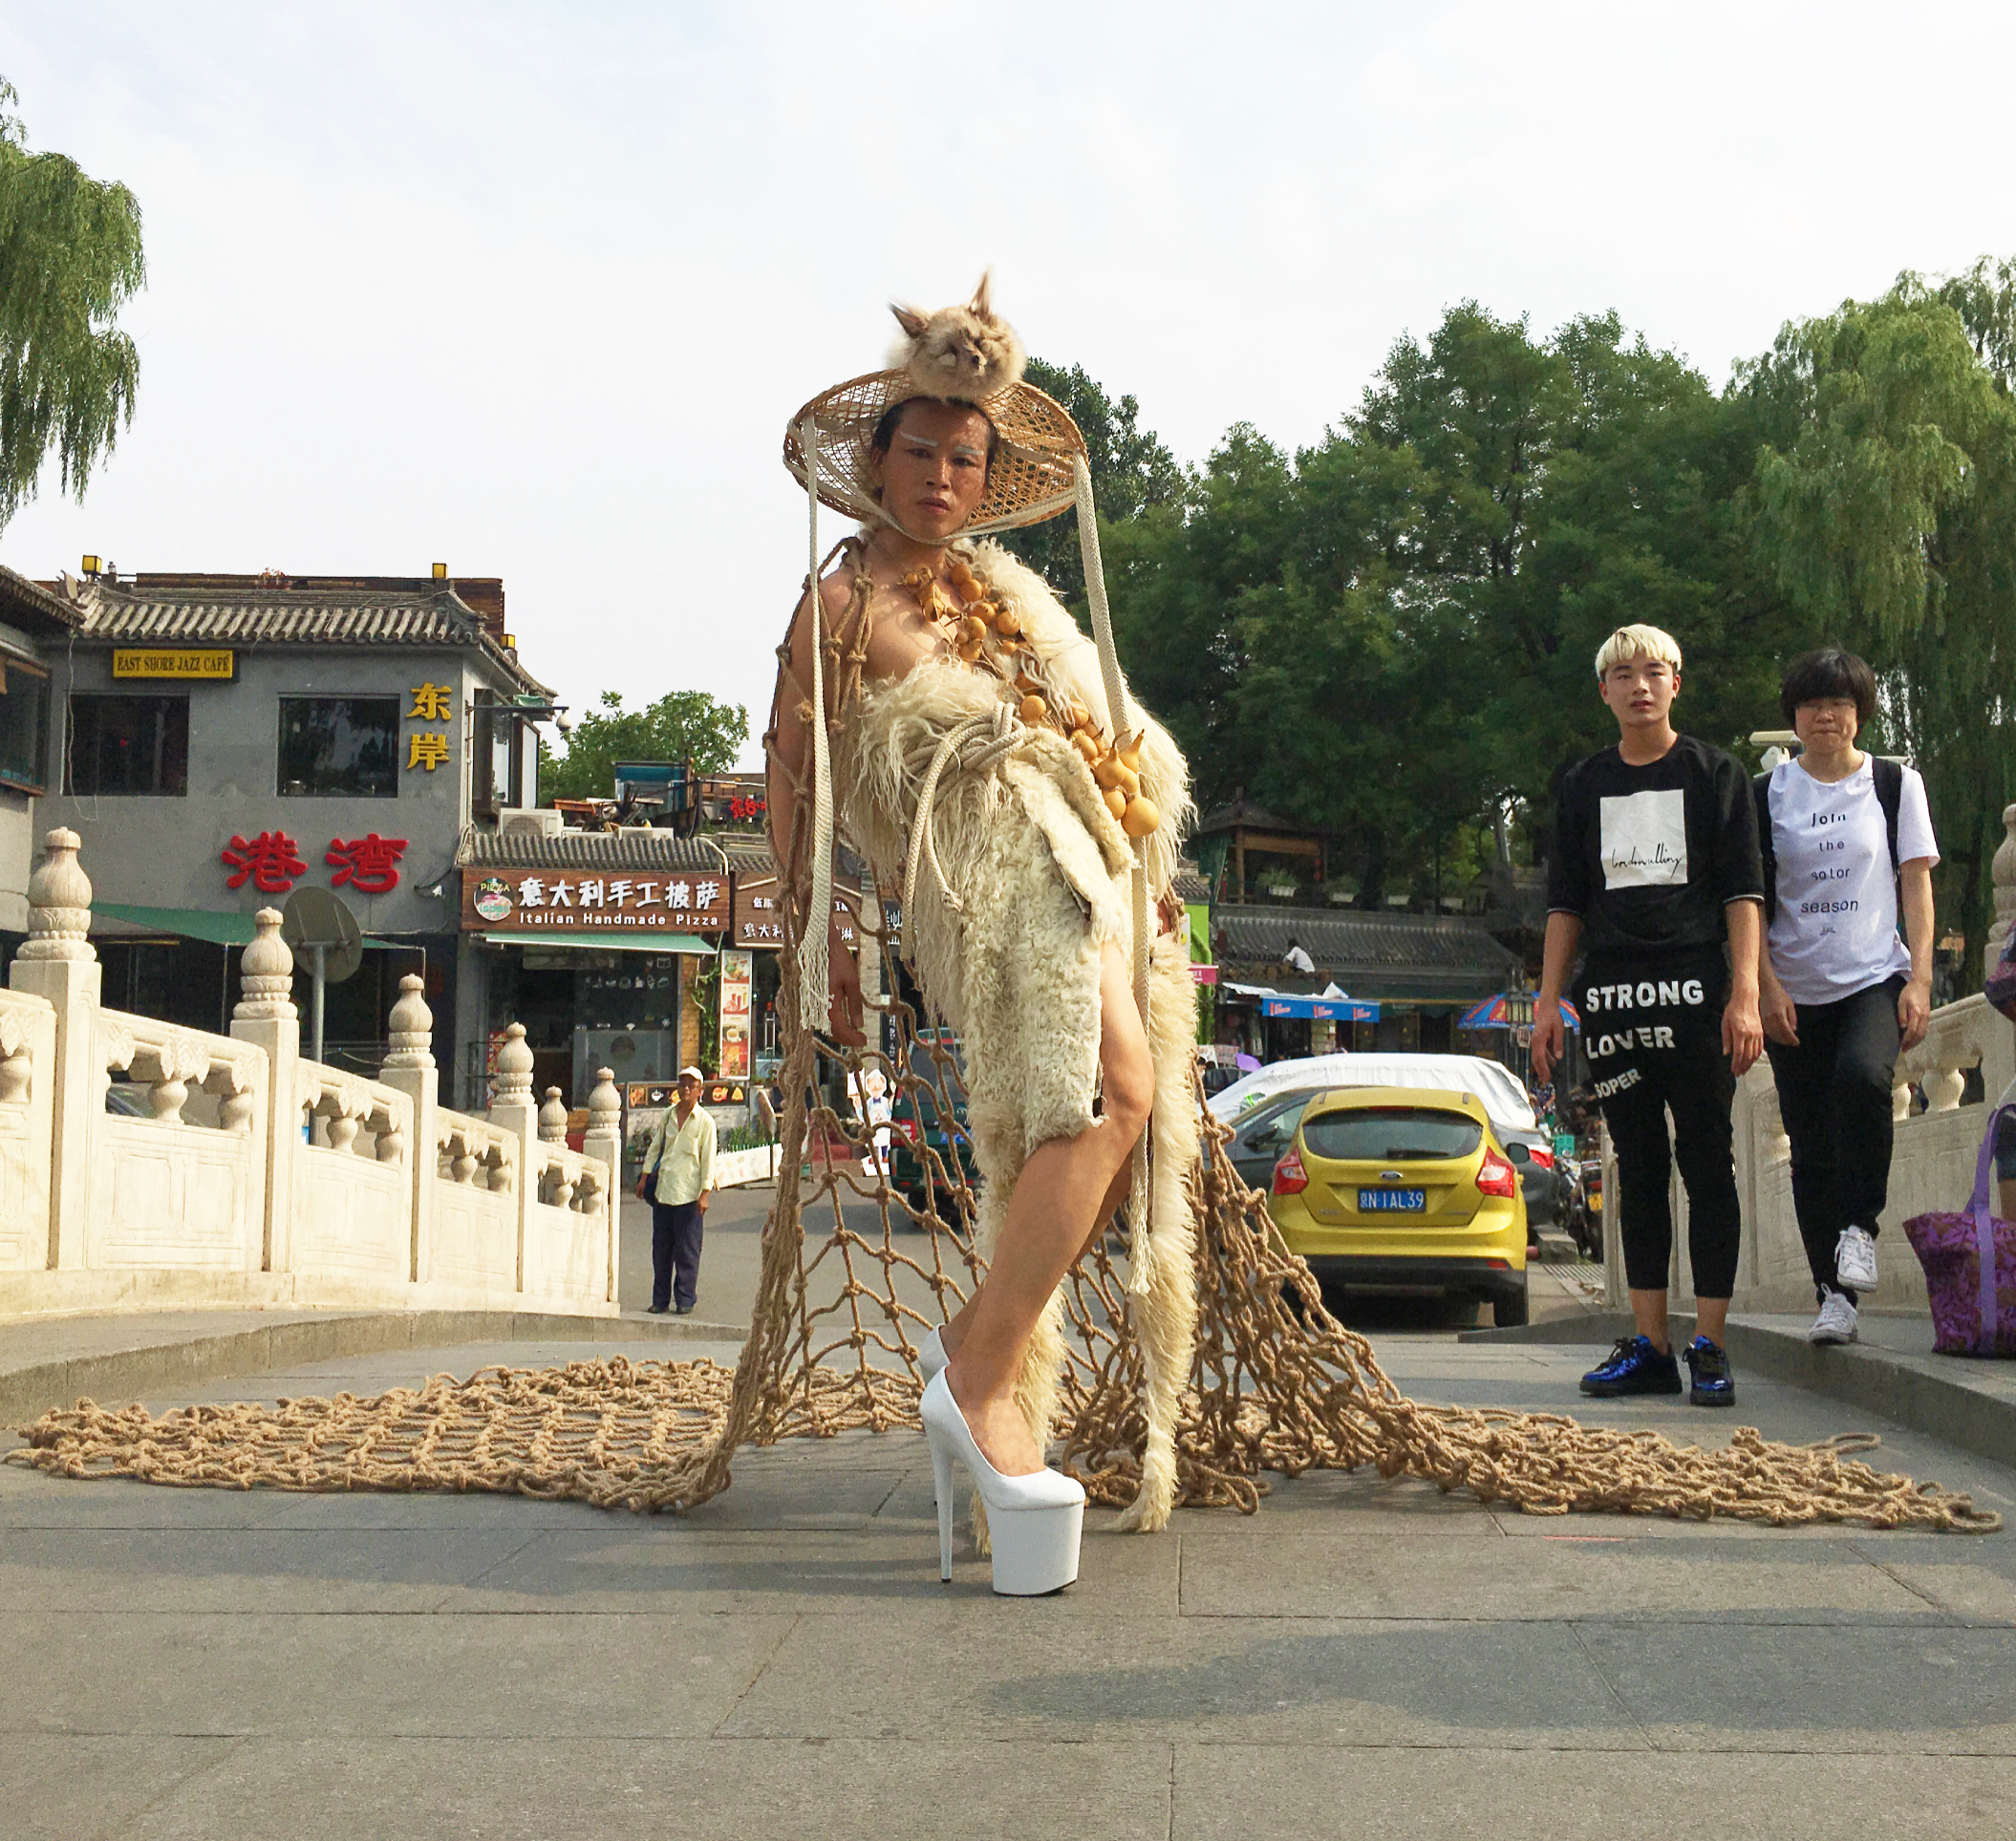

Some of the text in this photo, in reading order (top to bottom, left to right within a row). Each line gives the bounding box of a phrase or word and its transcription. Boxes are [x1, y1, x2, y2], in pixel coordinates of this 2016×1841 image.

[118, 656, 140, 671] EAST
[144, 656, 175, 671] SHORE
[178, 656, 201, 672] JAZZ
[406, 682, 452, 771] 东岸
[1819, 841, 1845, 852] the
[222, 830, 410, 893] 港湾
[481, 883, 510, 892] PIZZA
[519, 877, 720, 910] 意大利手工披萨
[1801, 900, 1858, 913] season
[521, 912, 718, 926] Italian Handmade Pizza
[1586, 979, 1705, 1013] STRONG
[1585, 1026, 1676, 1060] LOVER
